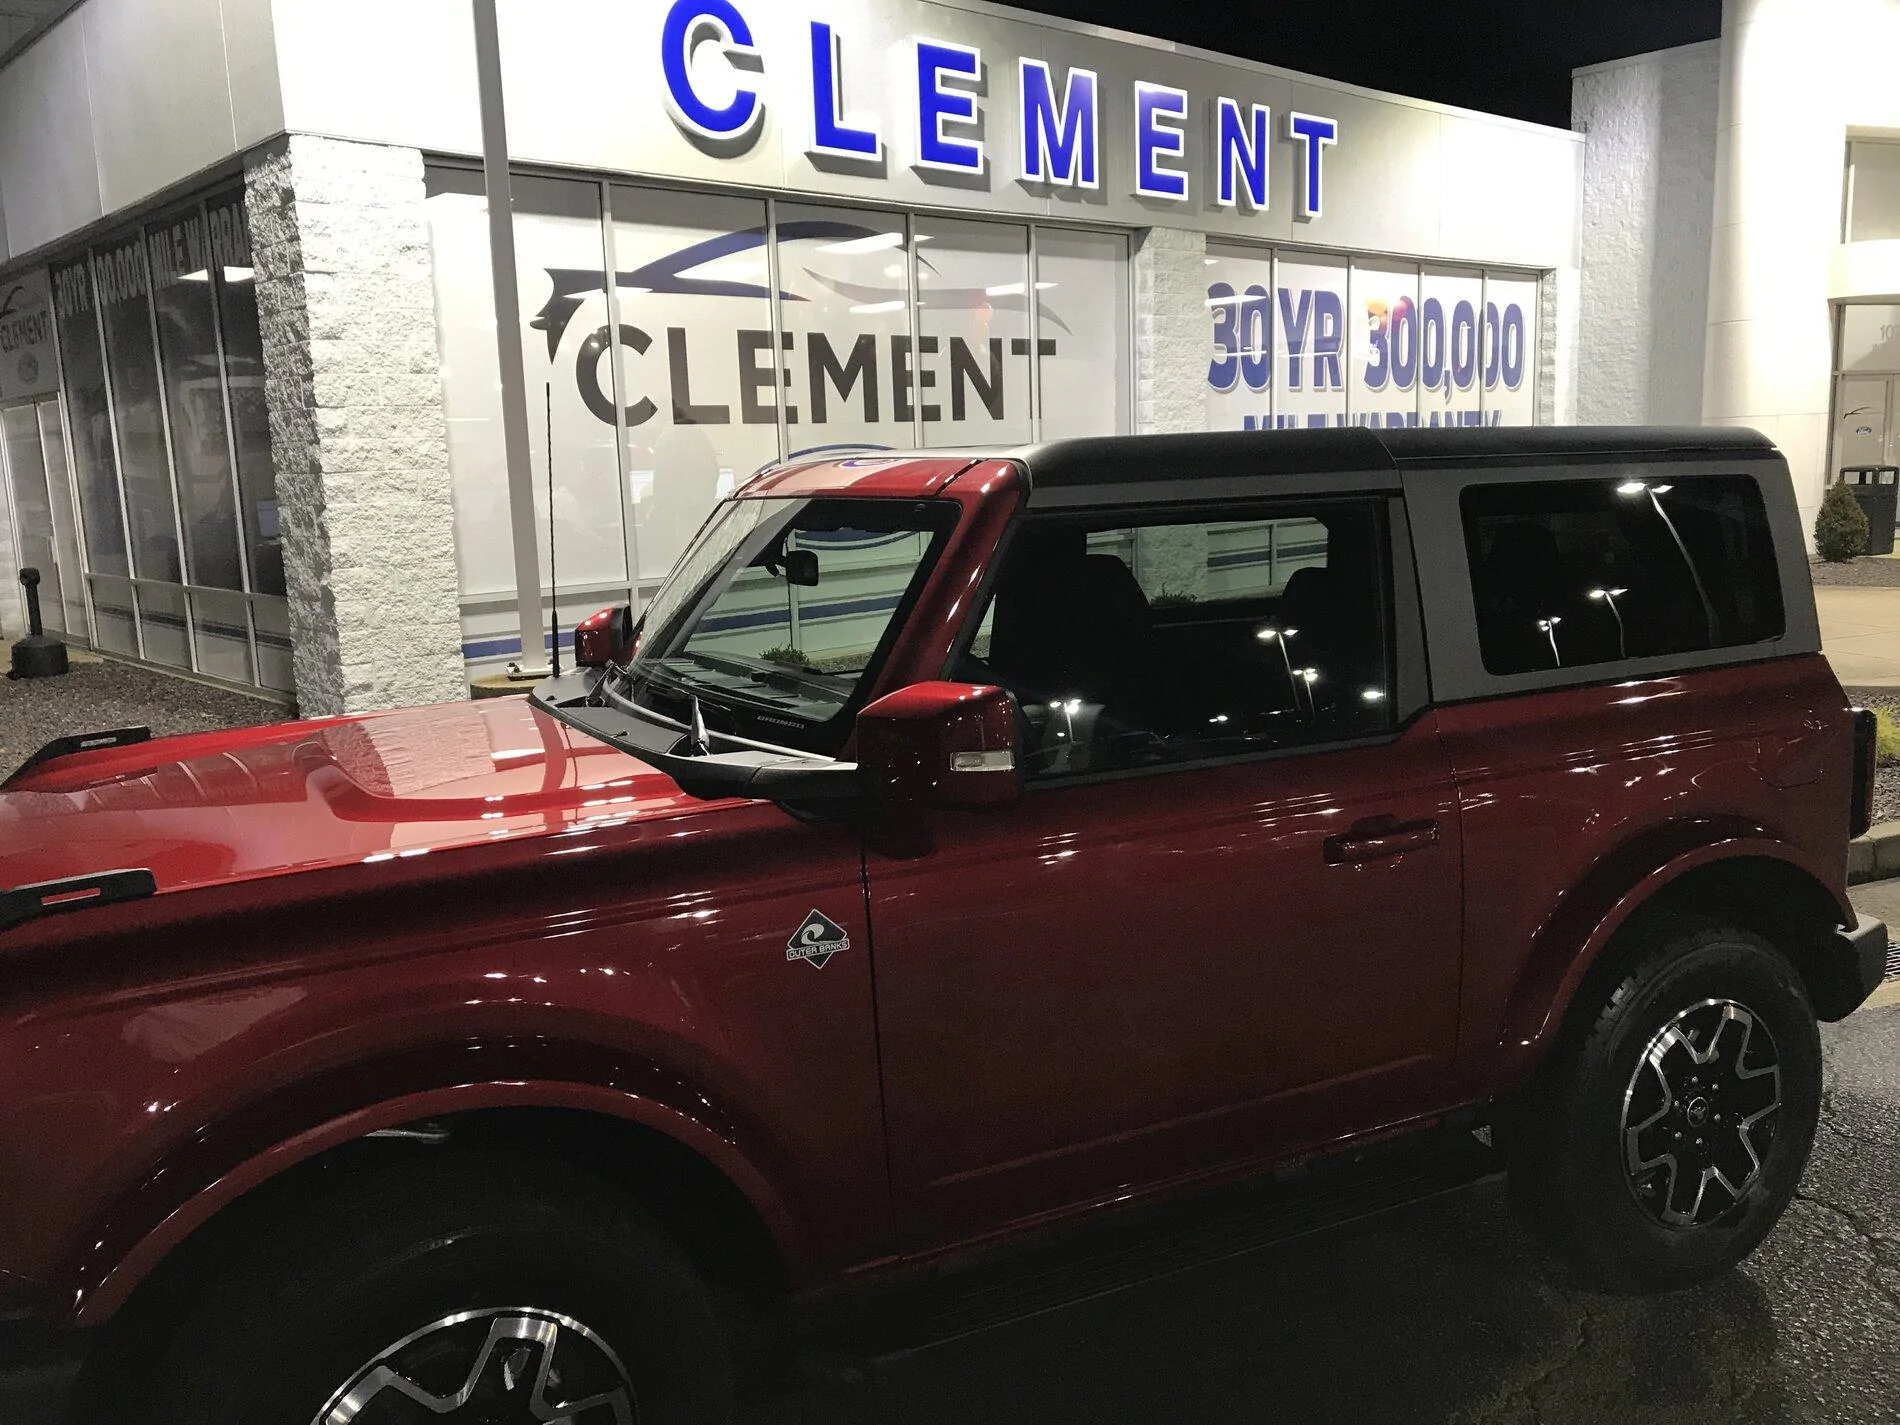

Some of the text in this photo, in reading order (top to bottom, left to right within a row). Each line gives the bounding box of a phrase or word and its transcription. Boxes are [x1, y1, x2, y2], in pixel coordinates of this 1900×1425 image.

[661, 0, 1338, 219] CLEMENT
[575, 323, 1057, 427] CLEMENT
[1206, 282, 1526, 404] 30YR 300,000
[788, 940, 848, 958] OUTER BANKS
